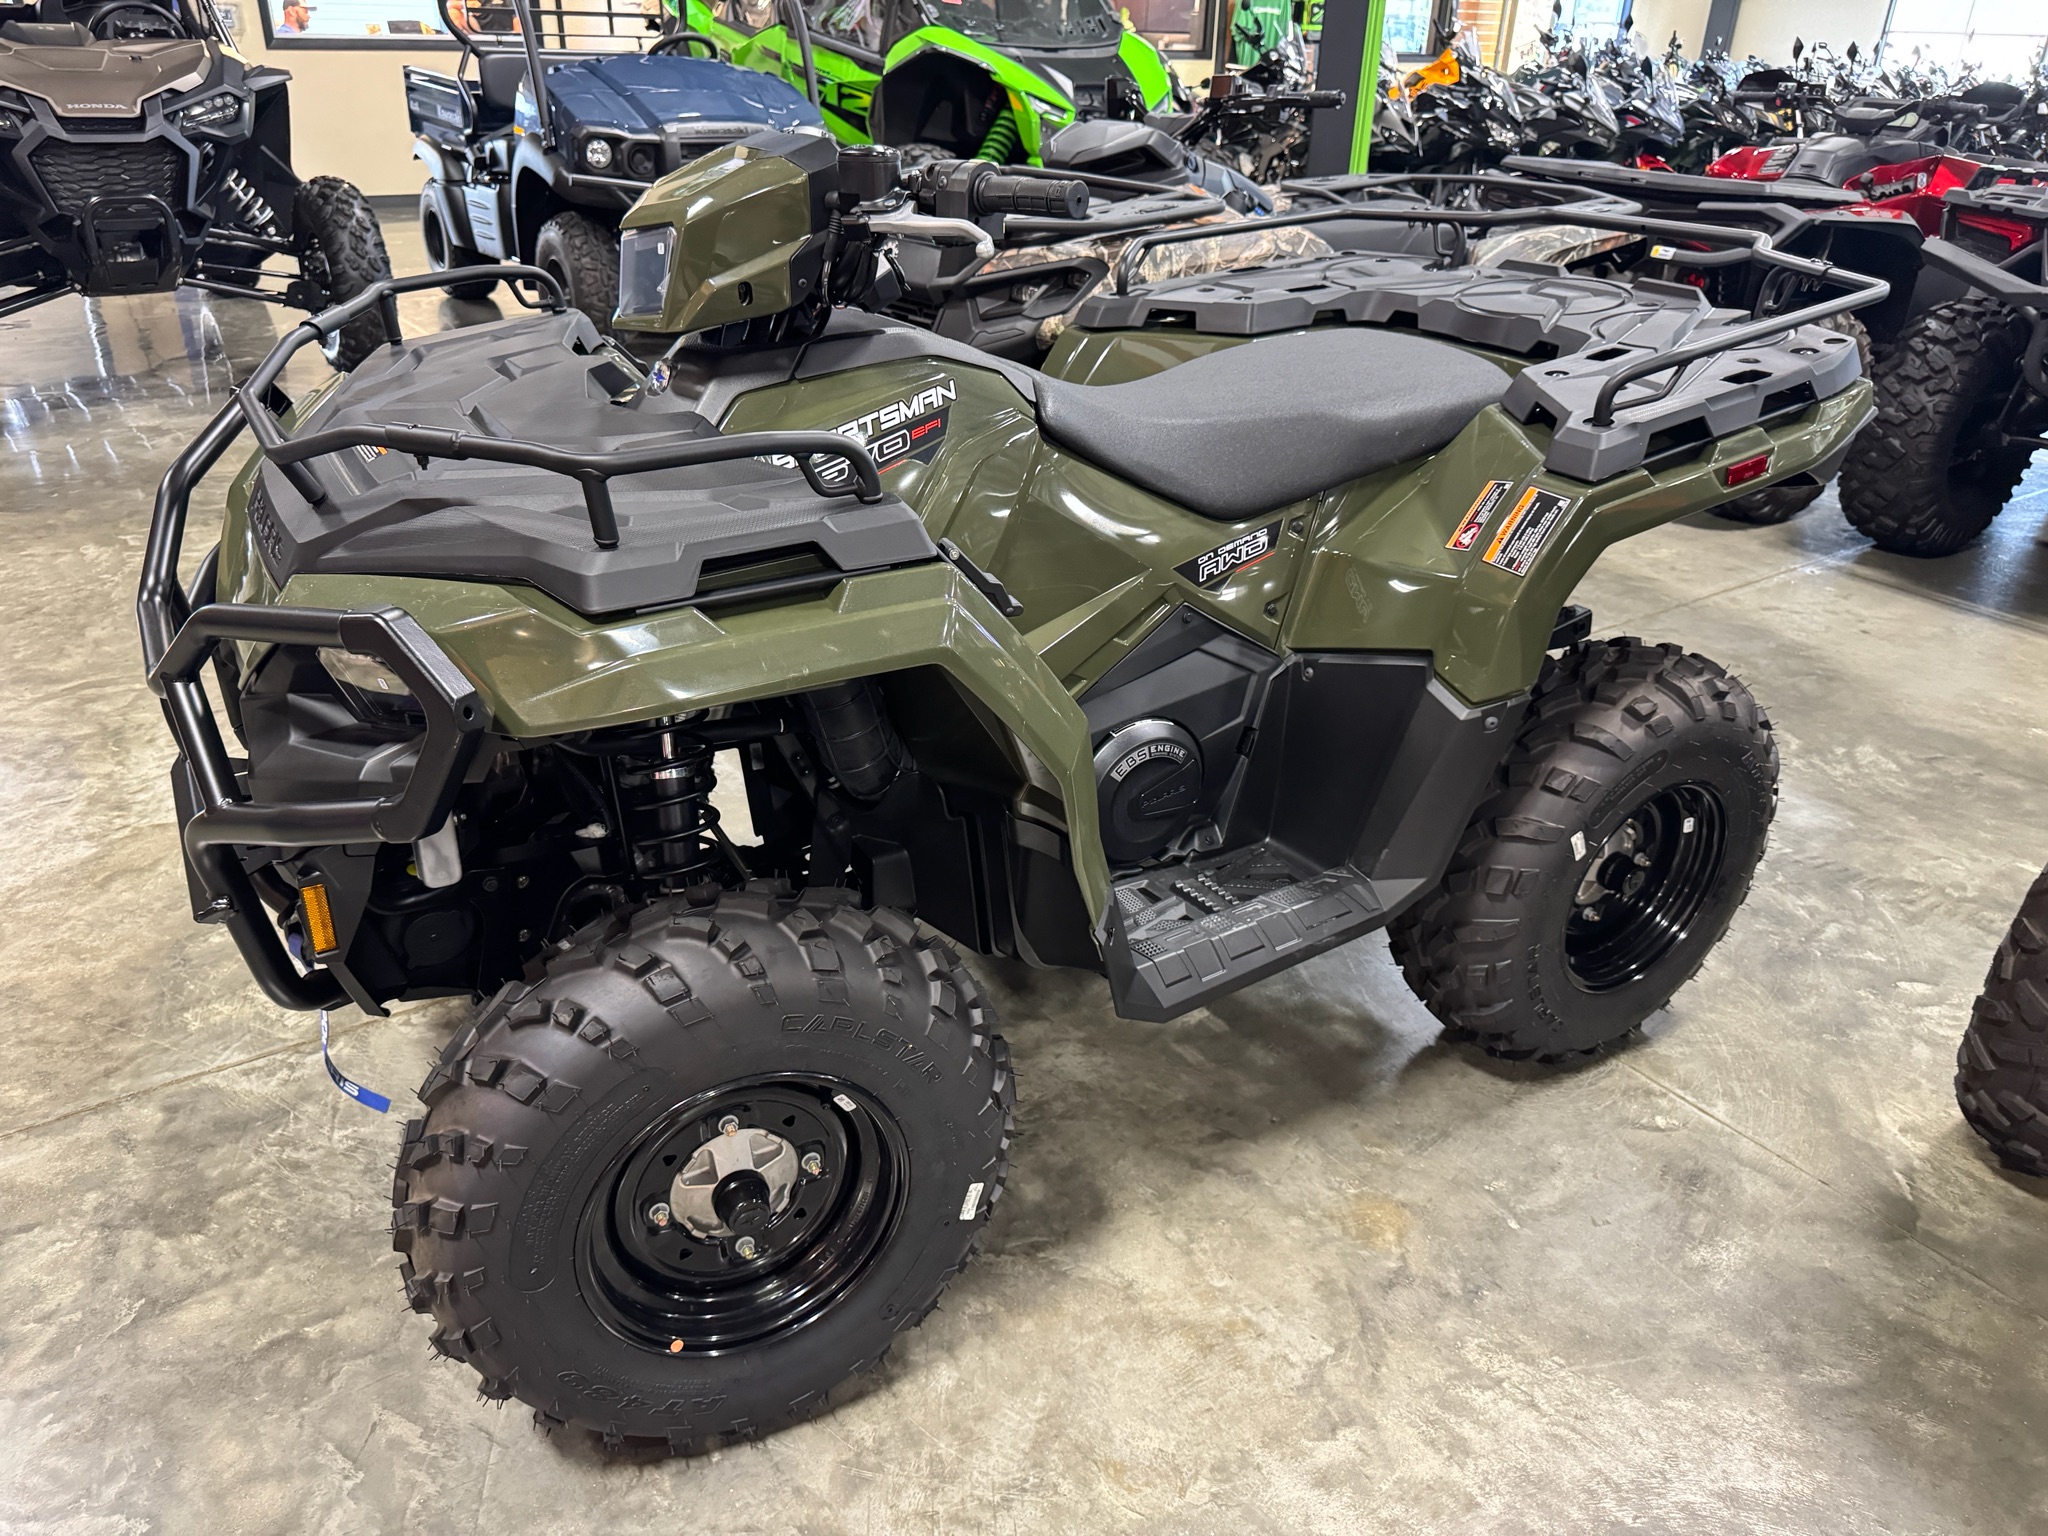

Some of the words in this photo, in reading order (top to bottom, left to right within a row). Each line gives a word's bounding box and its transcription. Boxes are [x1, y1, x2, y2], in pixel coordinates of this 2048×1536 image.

[694, 126, 749, 136] Kawasaki
[911, 418, 941, 440] EFI
[1501, 504, 1525, 536] WARNING
[1198, 551, 1214, 564] ON
[1218, 528, 1267, 554] DEMAND
[1199, 536, 1269, 582] AWD
[1115, 749, 1147, 777] EBS
[1150, 744, 1186, 758] ENGINE
[781, 1013, 943, 1084] CARLSTAR
